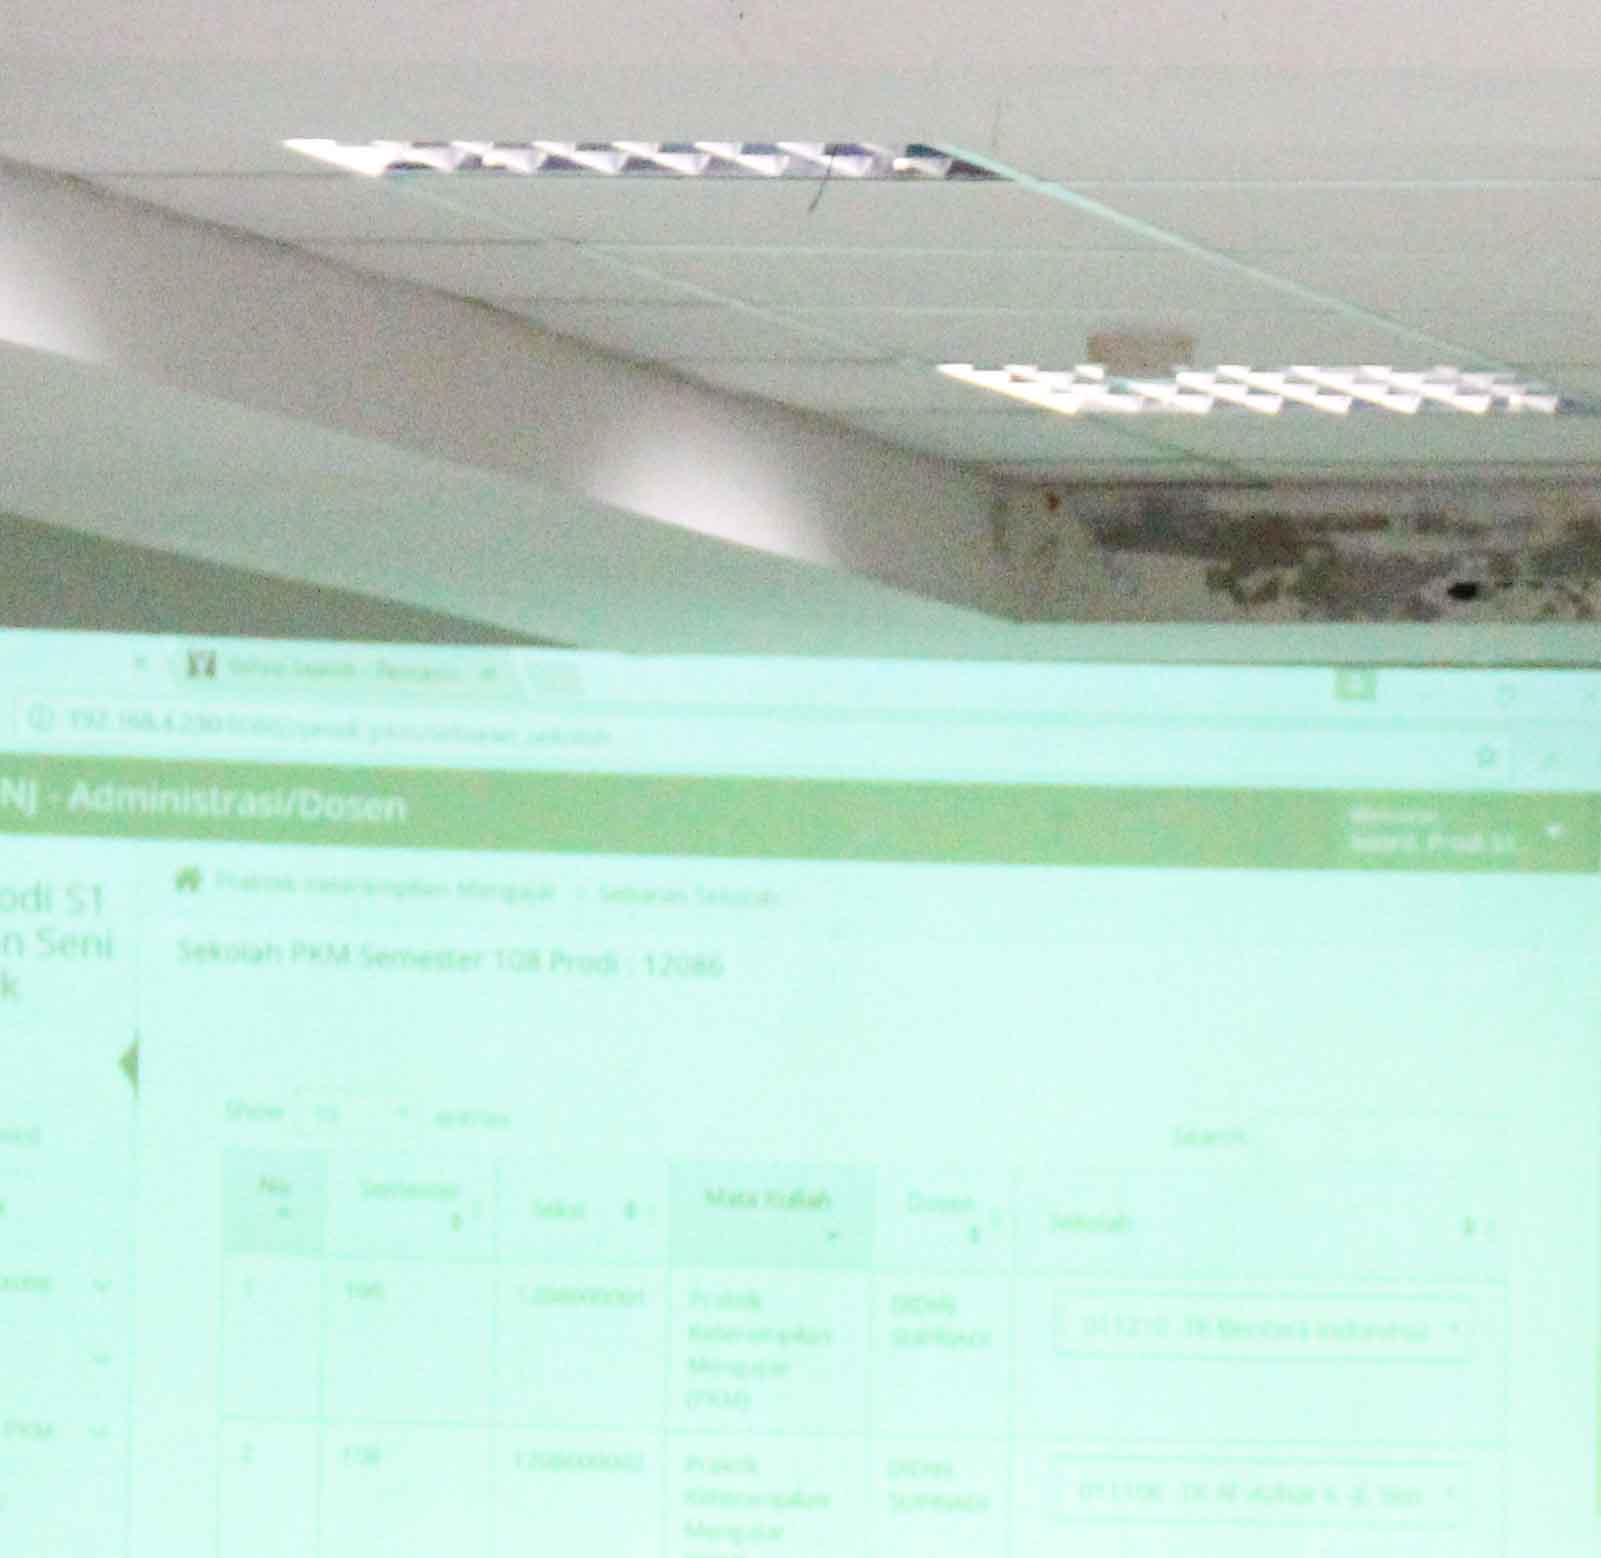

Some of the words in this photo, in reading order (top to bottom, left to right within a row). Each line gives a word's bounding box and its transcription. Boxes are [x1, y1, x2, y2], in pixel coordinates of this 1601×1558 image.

[68, 780, 407, 822] Administrasi/Dosen
[35, 930, 114, 960] Seni
[177, 937, 284, 968] Sekolah
[361, 942, 482, 974] Semester
